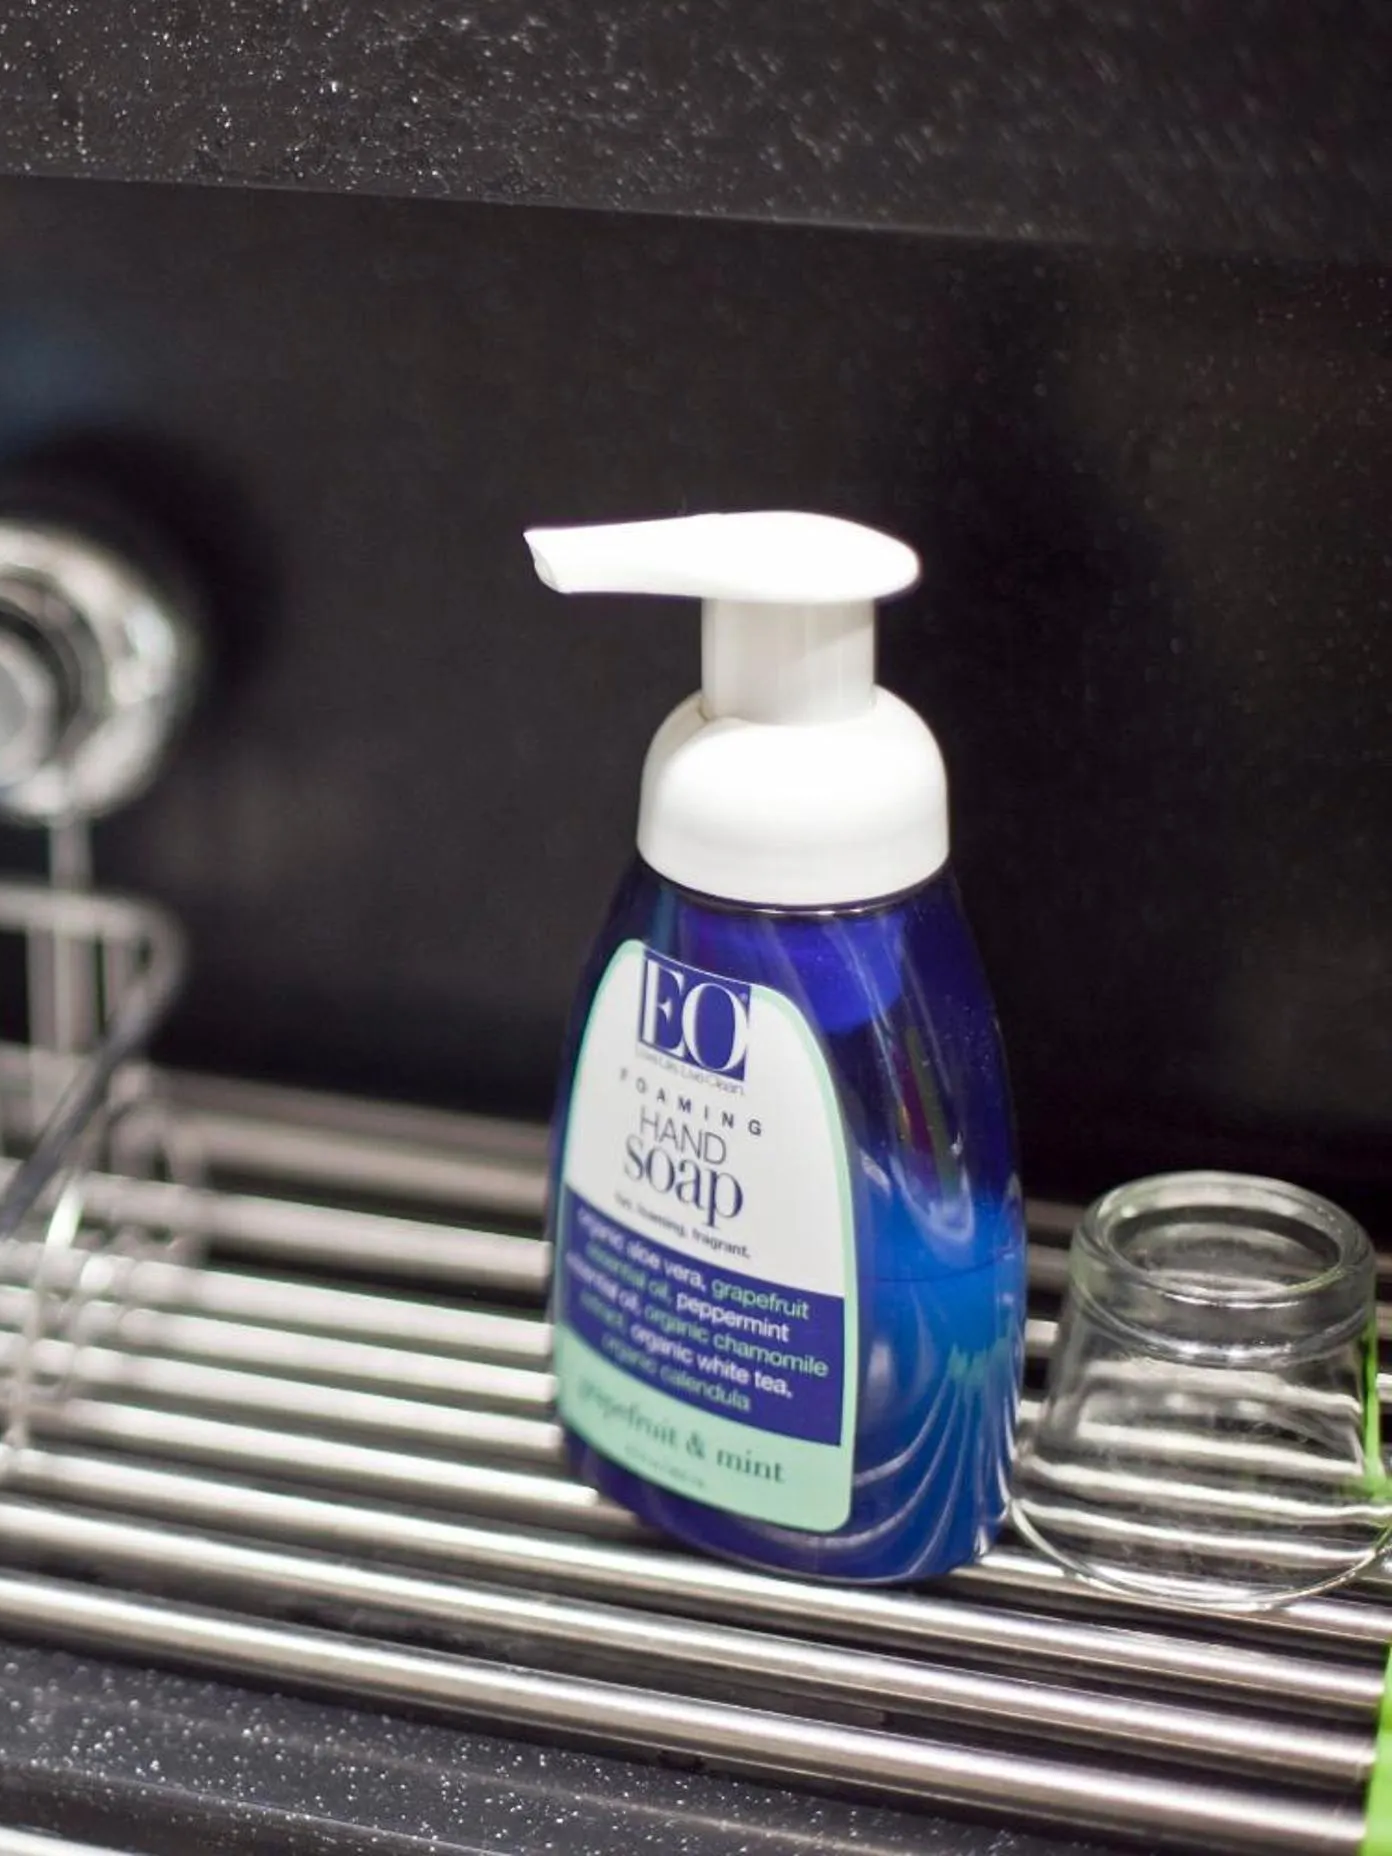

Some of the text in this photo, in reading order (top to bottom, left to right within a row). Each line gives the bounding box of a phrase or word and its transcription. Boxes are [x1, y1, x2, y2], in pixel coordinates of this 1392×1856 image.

[641, 958, 749, 1072] EO
[619, 1067, 763, 1136] FOAMING
[640, 1106, 727, 1166] HAND
[624, 1133, 744, 1230] soap
[627, 1239, 661, 1270] aloe
[711, 1279, 810, 1321] grapefruit
[644, 1303, 710, 1345] organic
[712, 1333, 829, 1378] chamomile
[676, 1292, 790, 1342] peppermint
[630, 1323, 694, 1365] organic
[696, 1353, 750, 1385] white
[660, 1365, 751, 1413] calendula
[686, 1431, 706, 1460] &
[716, 1447, 785, 1484] mint
